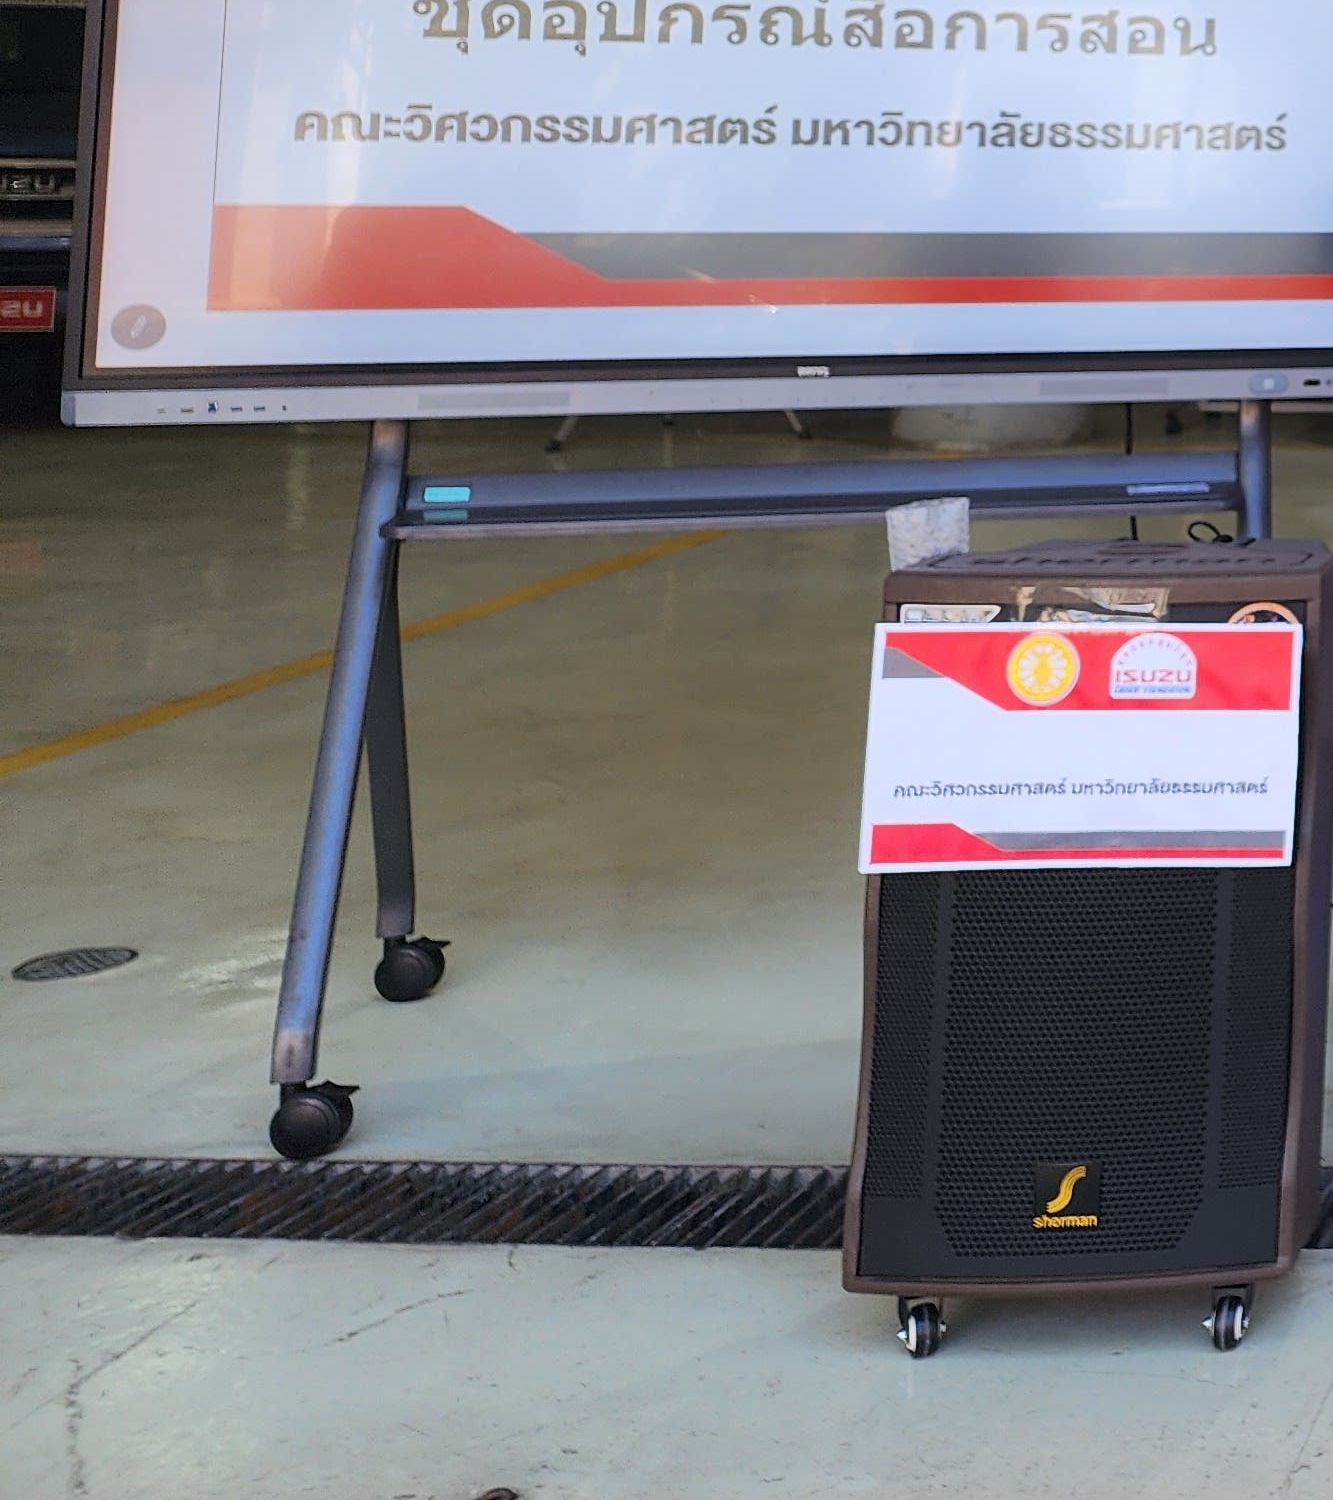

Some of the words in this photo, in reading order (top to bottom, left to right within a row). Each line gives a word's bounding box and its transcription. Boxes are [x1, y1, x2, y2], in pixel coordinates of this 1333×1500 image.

[294, 104, 778, 146] คณะวิศวกรรมศาสตร์
[791, 111, 1288, 151] มหาวิทยาลัยธรรมศาสตร์
[1116, 669, 1191, 683] ISUZU
[1032, 1215, 1098, 1228] sherman
